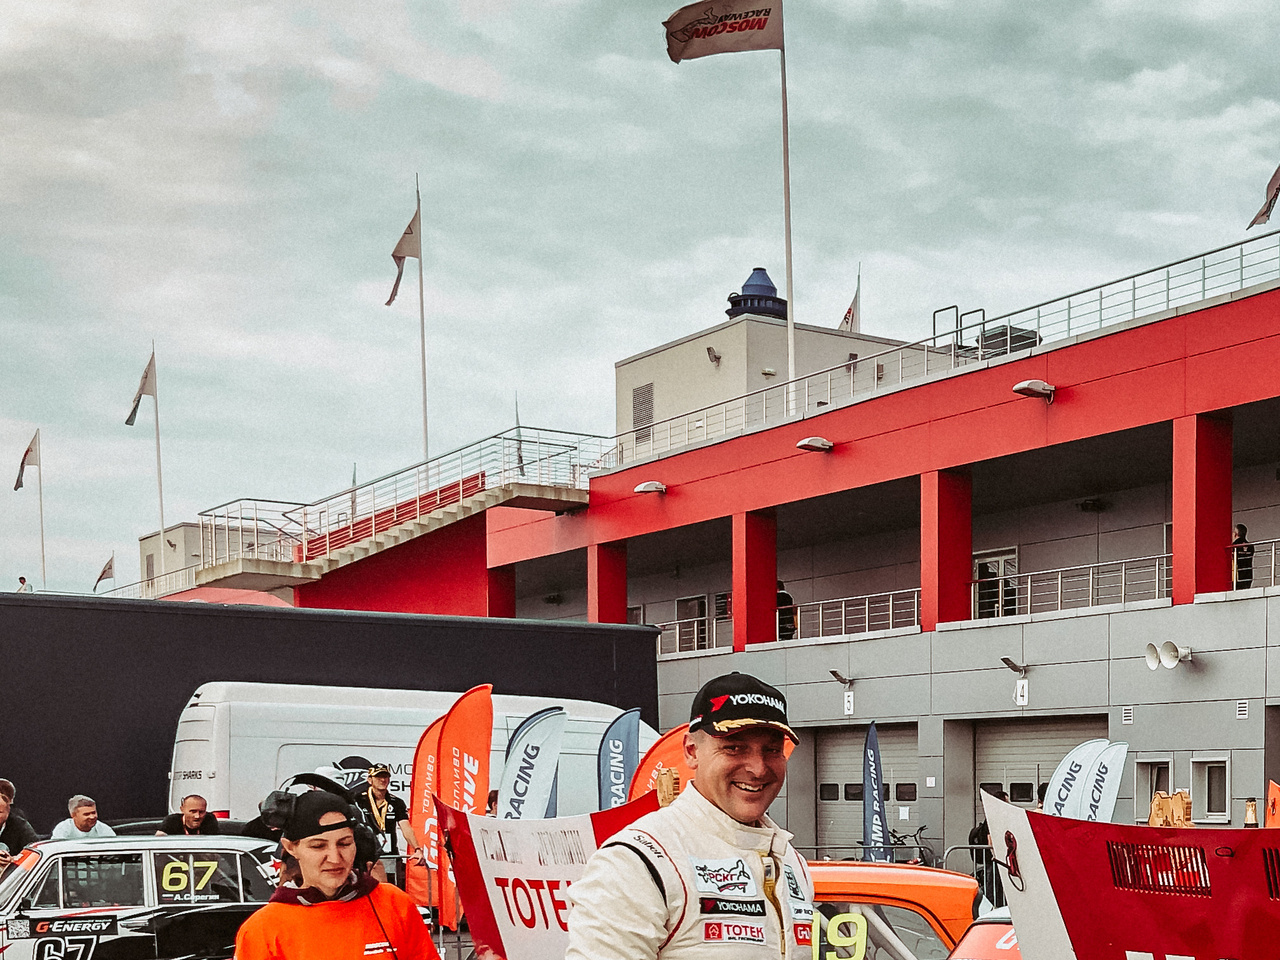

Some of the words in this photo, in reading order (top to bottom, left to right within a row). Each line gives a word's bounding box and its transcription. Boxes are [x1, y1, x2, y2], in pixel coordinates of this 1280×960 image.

[691, 17, 768, 39] MOSCOW
[730, 694, 786, 715] YOKOHAMA
[1019, 684, 1025, 701] 4
[461, 752, 479, 815] RIVE
[505, 744, 540, 819] RACING
[610, 739, 625, 808] RACING
[867, 749, 881, 812] RACING
[1053, 760, 1083, 816] ACING
[162, 861, 218, 892] 67
[494, 877, 575, 932] TOTE
[717, 902, 763, 913] YOKOHAMA
[724, 924, 764, 938] TOTEK
